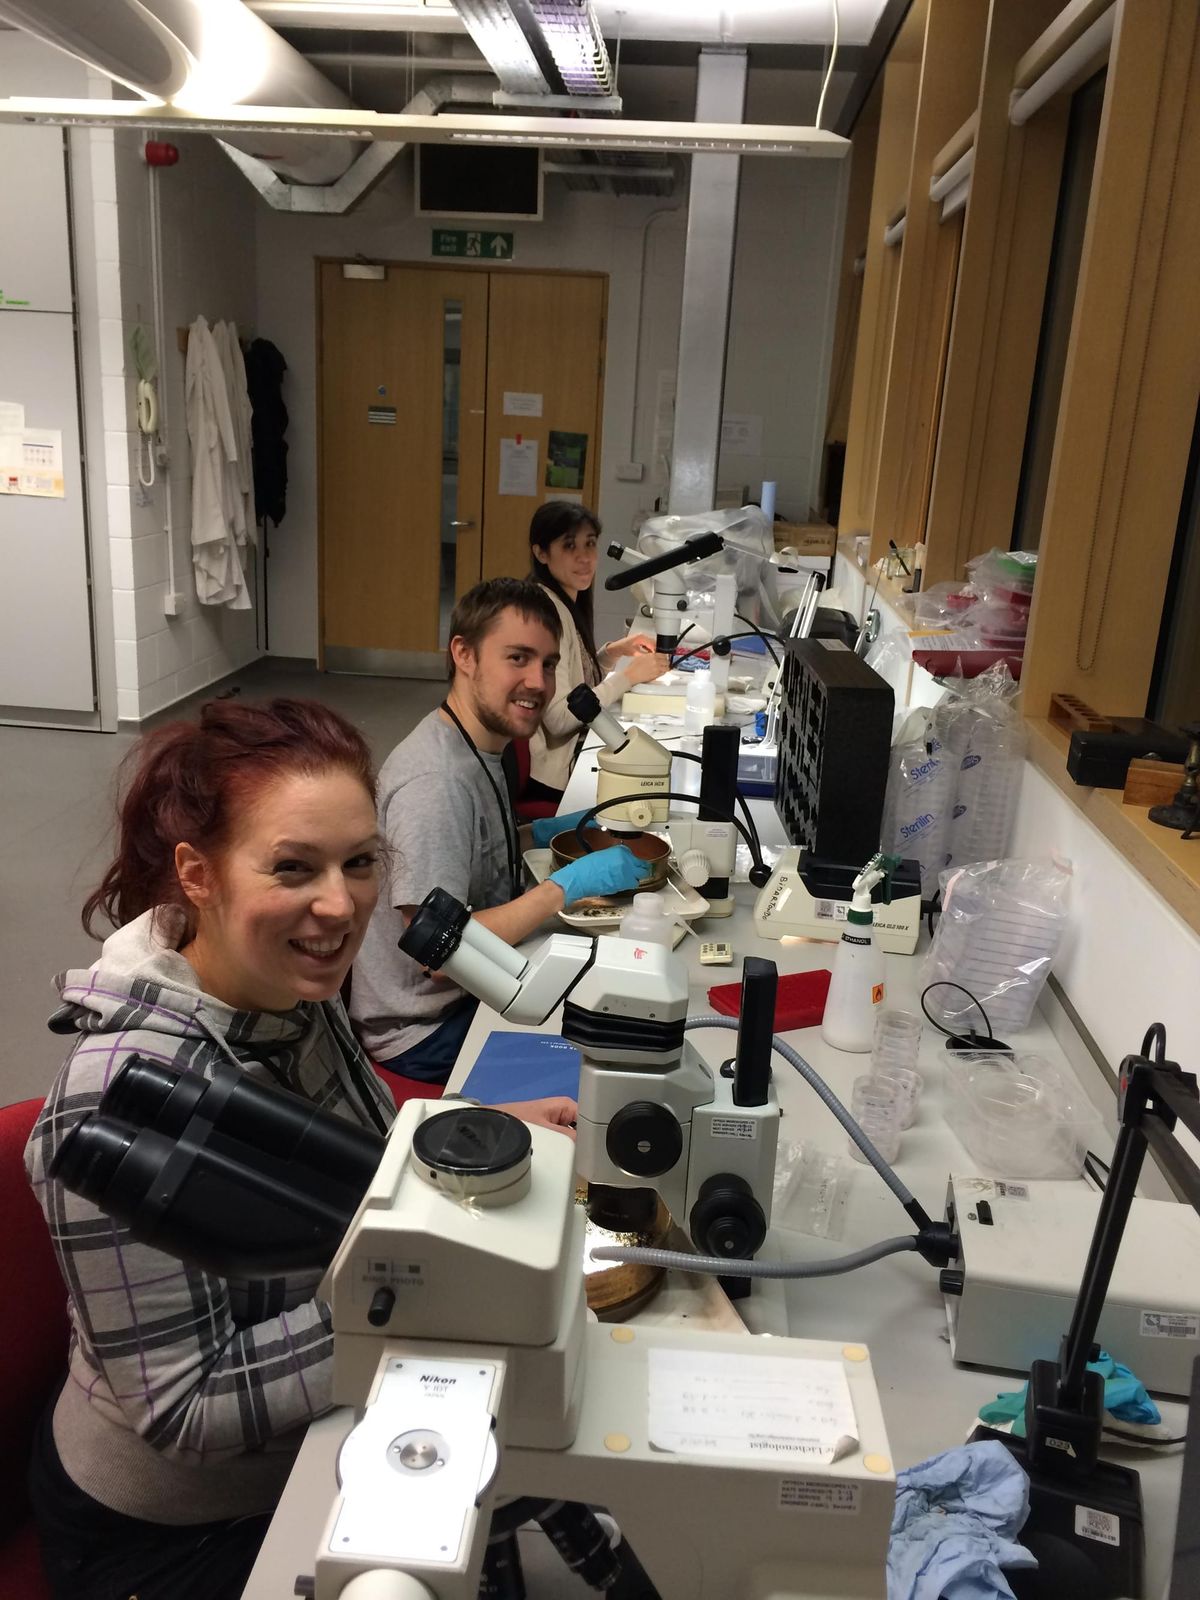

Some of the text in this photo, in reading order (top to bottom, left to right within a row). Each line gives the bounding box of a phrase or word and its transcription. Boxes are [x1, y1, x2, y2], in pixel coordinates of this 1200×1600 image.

[900, 813, 935, 839] Sterilin
[844, 936, 868, 945] ETHANOL
[419, 1374, 457, 1385] Nikon
[749, 1441, 823, 1456] Lichenologist
